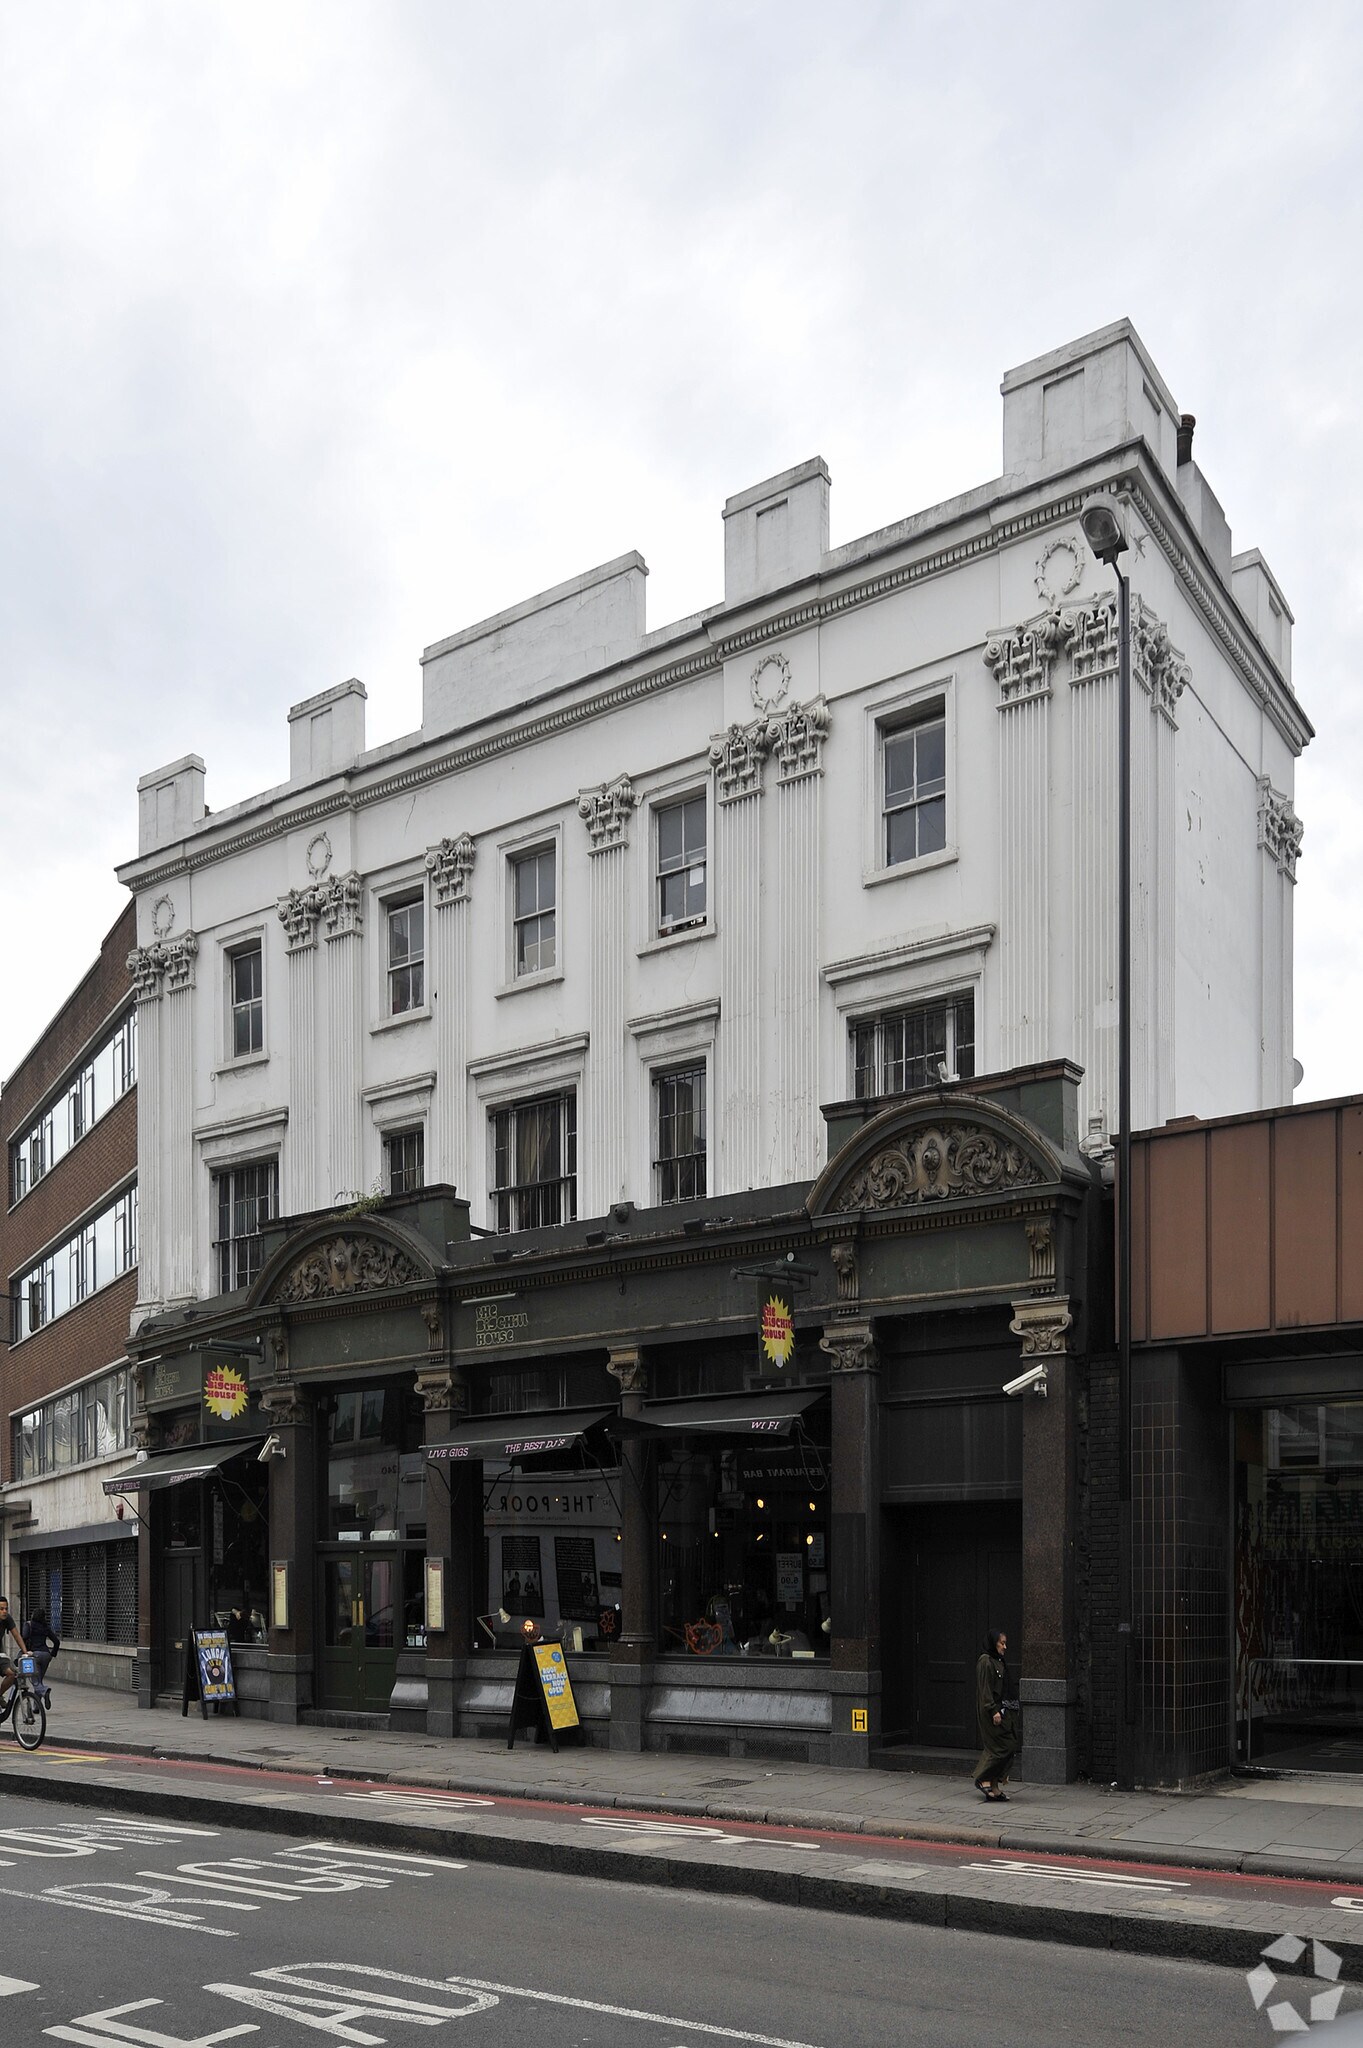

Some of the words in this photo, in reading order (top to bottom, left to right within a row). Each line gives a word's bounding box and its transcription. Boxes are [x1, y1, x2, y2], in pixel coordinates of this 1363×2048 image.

[751, 1421, 766, 1430] WI
[767, 1421, 780, 1430] FI
[427, 1449, 447, 1459] LIVE
[448, 1447, 469, 1457] GIGS
[505, 1443, 521, 1454] THE
[522, 1441, 545, 1451] BEST
[545, 1438, 566, 1448] DJ'S
[854, 1711, 865, 1730] H
[41, 1841, 469, 1922] RIGHT
